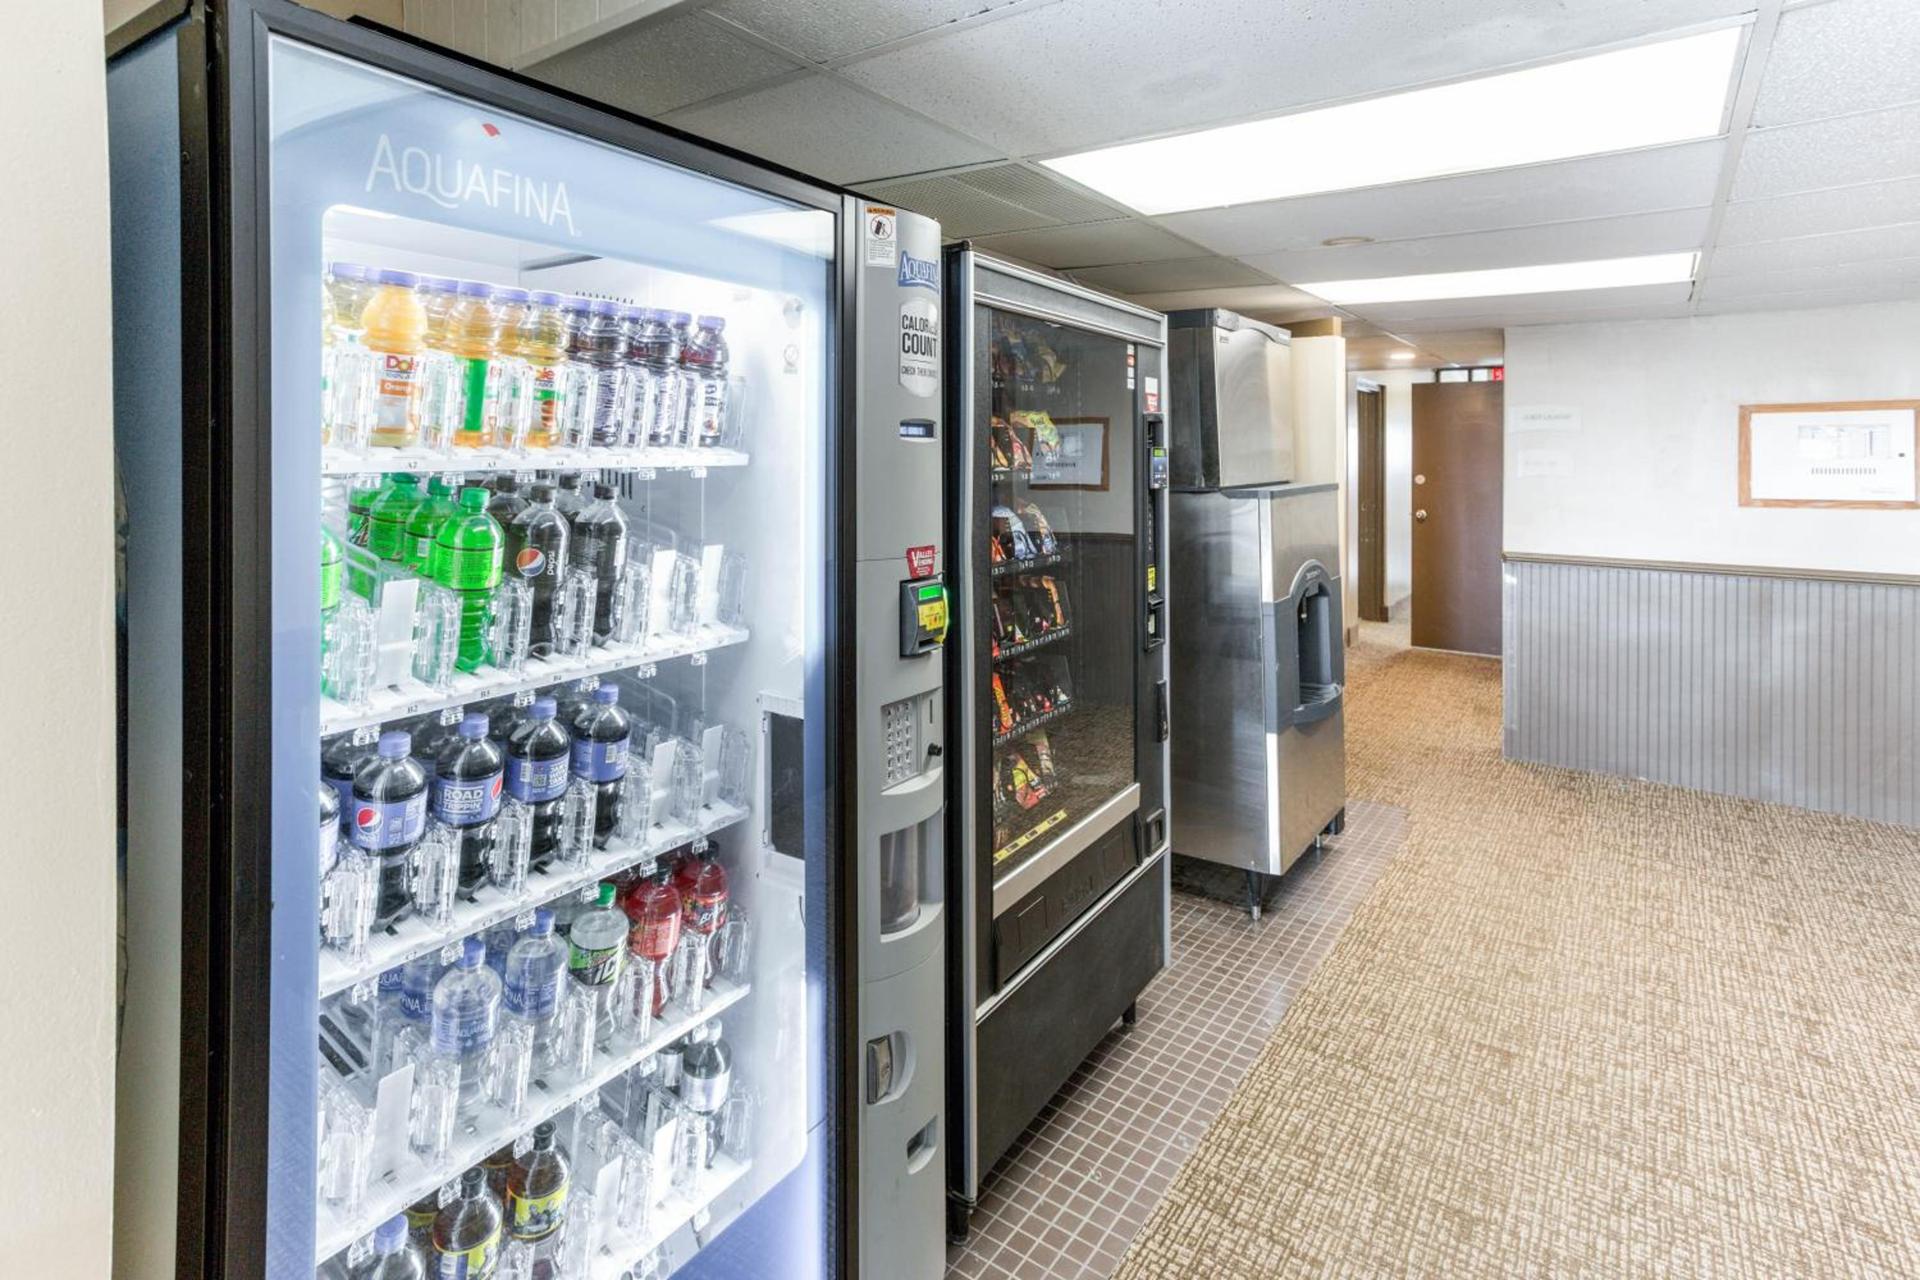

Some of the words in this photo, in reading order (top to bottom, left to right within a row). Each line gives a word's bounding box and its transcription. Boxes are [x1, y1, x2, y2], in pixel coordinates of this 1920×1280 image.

[365, 133, 577, 237] AQUAFINA
[902, 332, 937, 358] COUNT
[444, 789, 483, 801] ROAD
